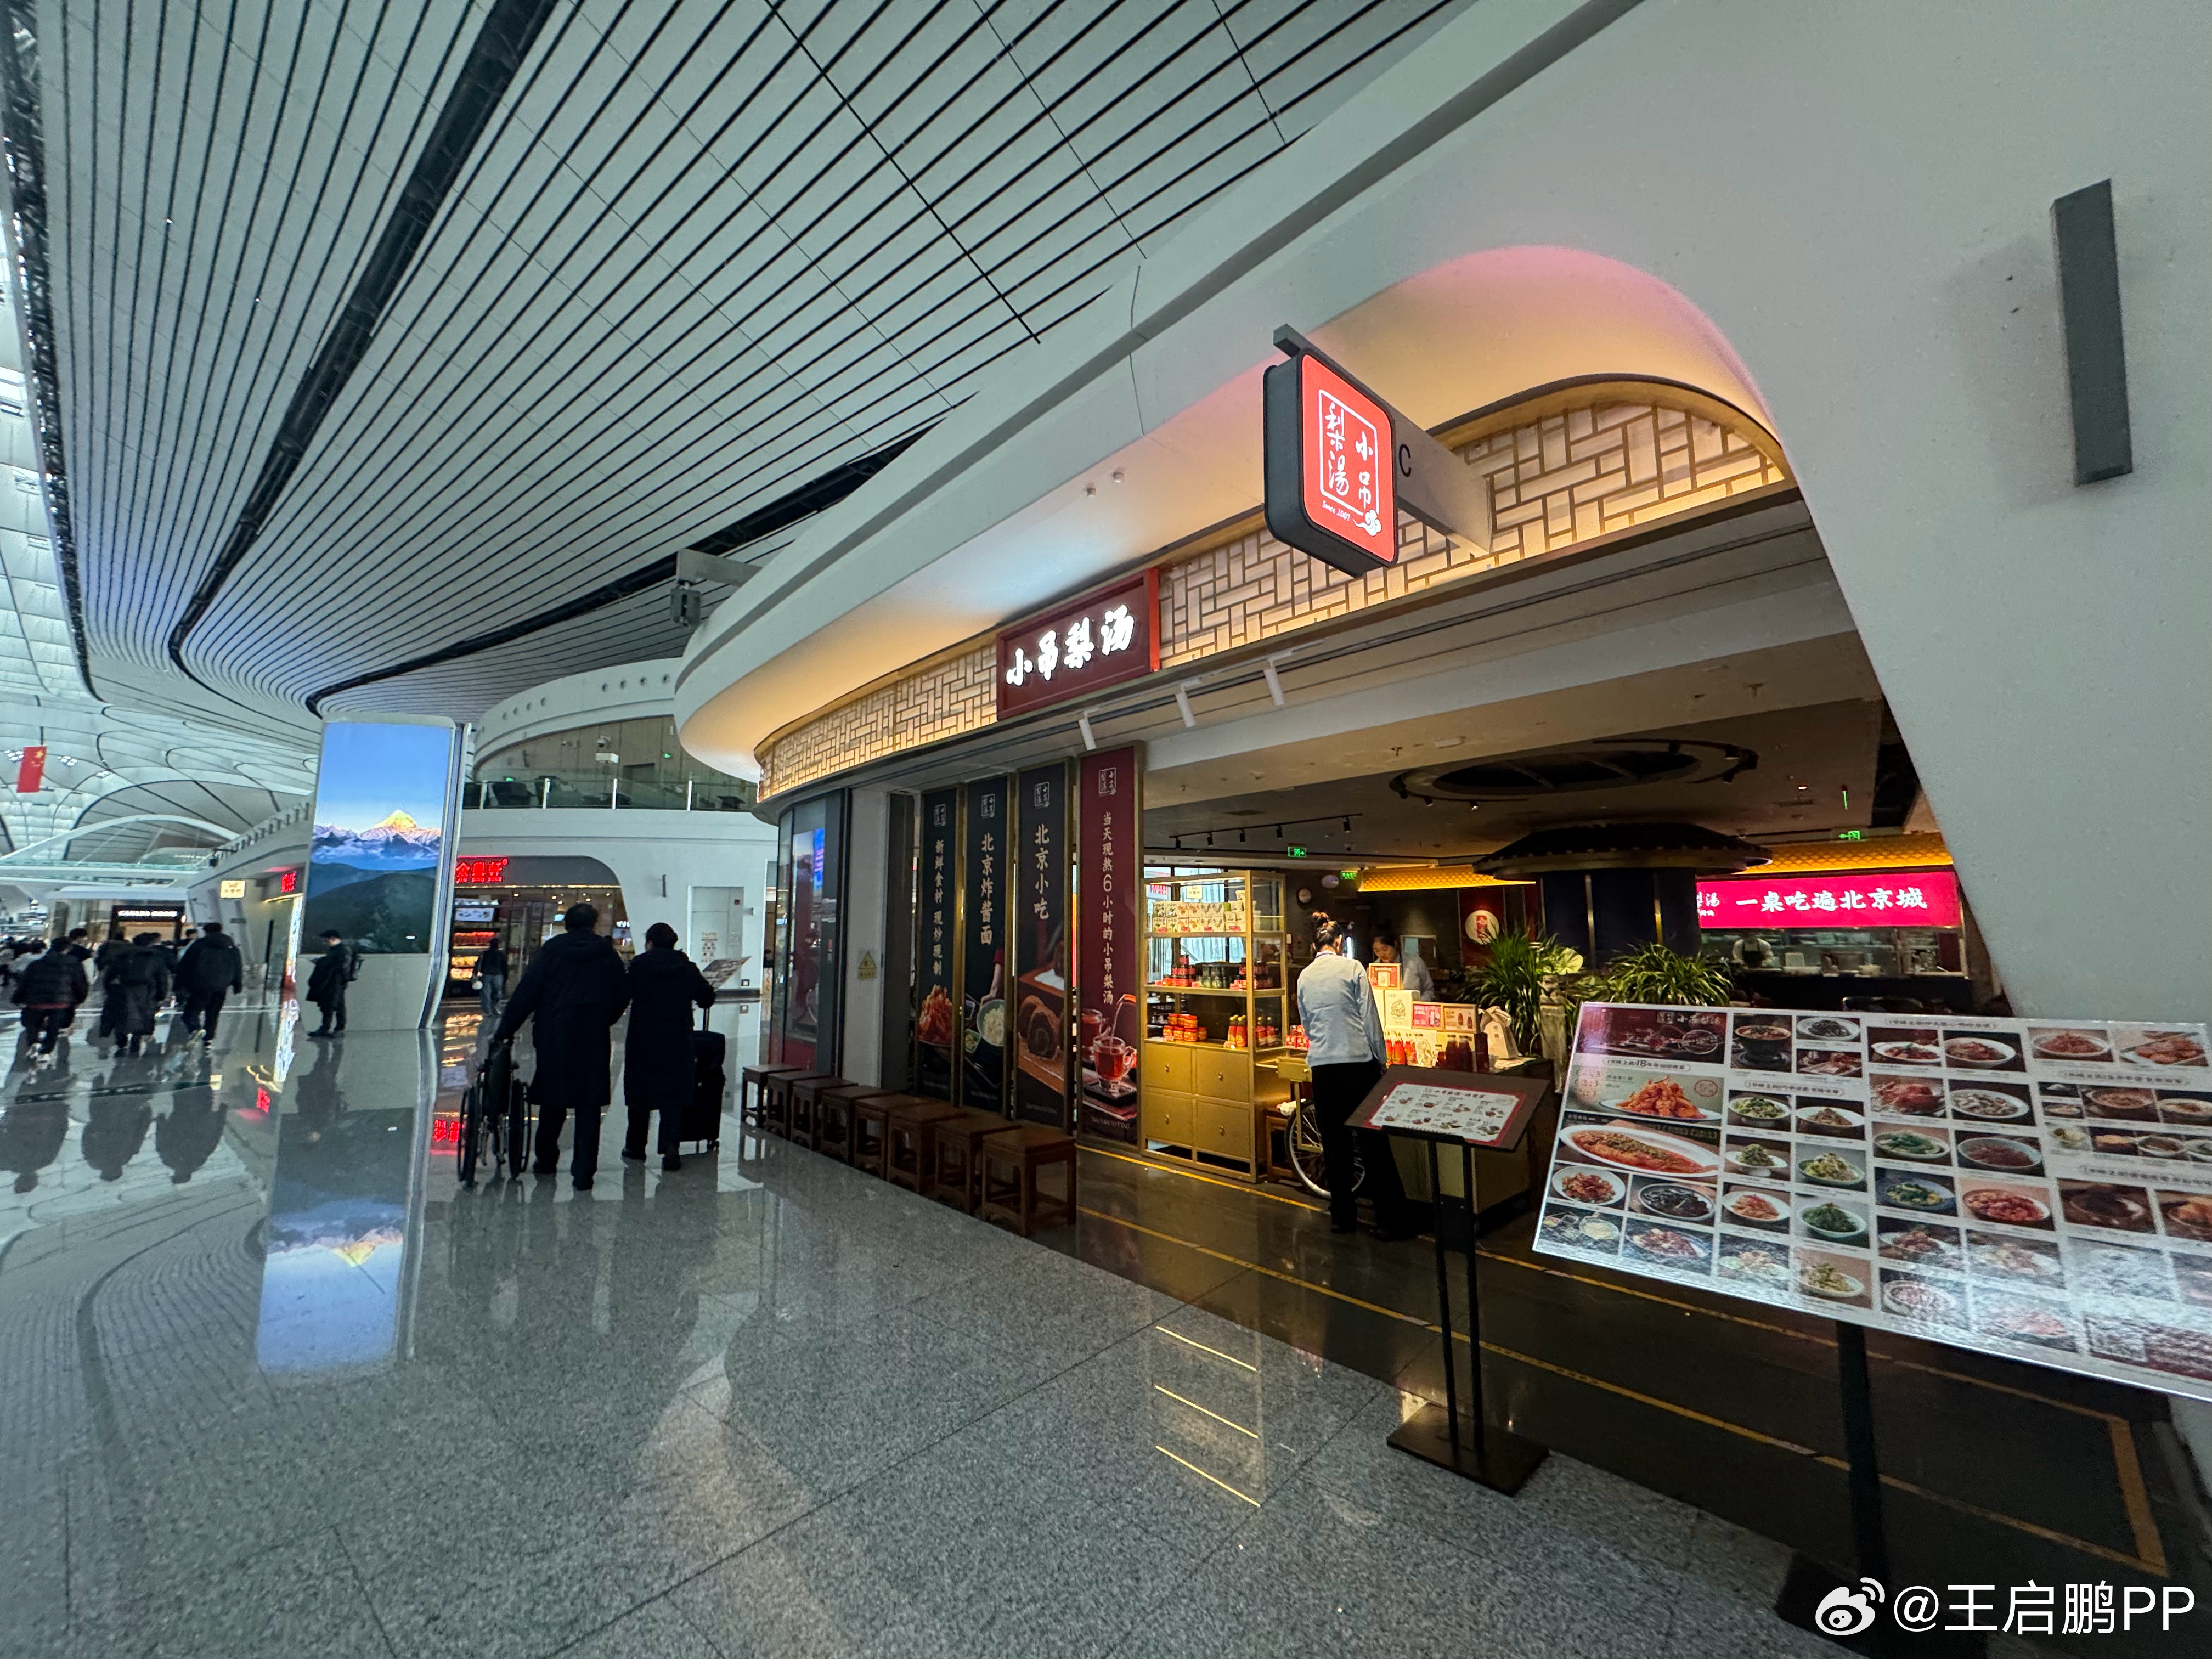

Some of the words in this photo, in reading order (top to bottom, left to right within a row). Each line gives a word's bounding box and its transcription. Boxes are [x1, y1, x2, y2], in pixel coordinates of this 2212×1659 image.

[1355, 431, 1374, 510] 小吊
[1398, 443, 1412, 478] C
[1006, 604, 1135, 686] 小吊梨汤
[980, 832, 994, 945] 北京炸酱面
[1033, 823, 1049, 919] 北京小吃
[1102, 811, 1113, 1005] 当天现熬6小时的小吊梨汤
[1735, 886, 1928, 913] 一桌吃遍北京城
